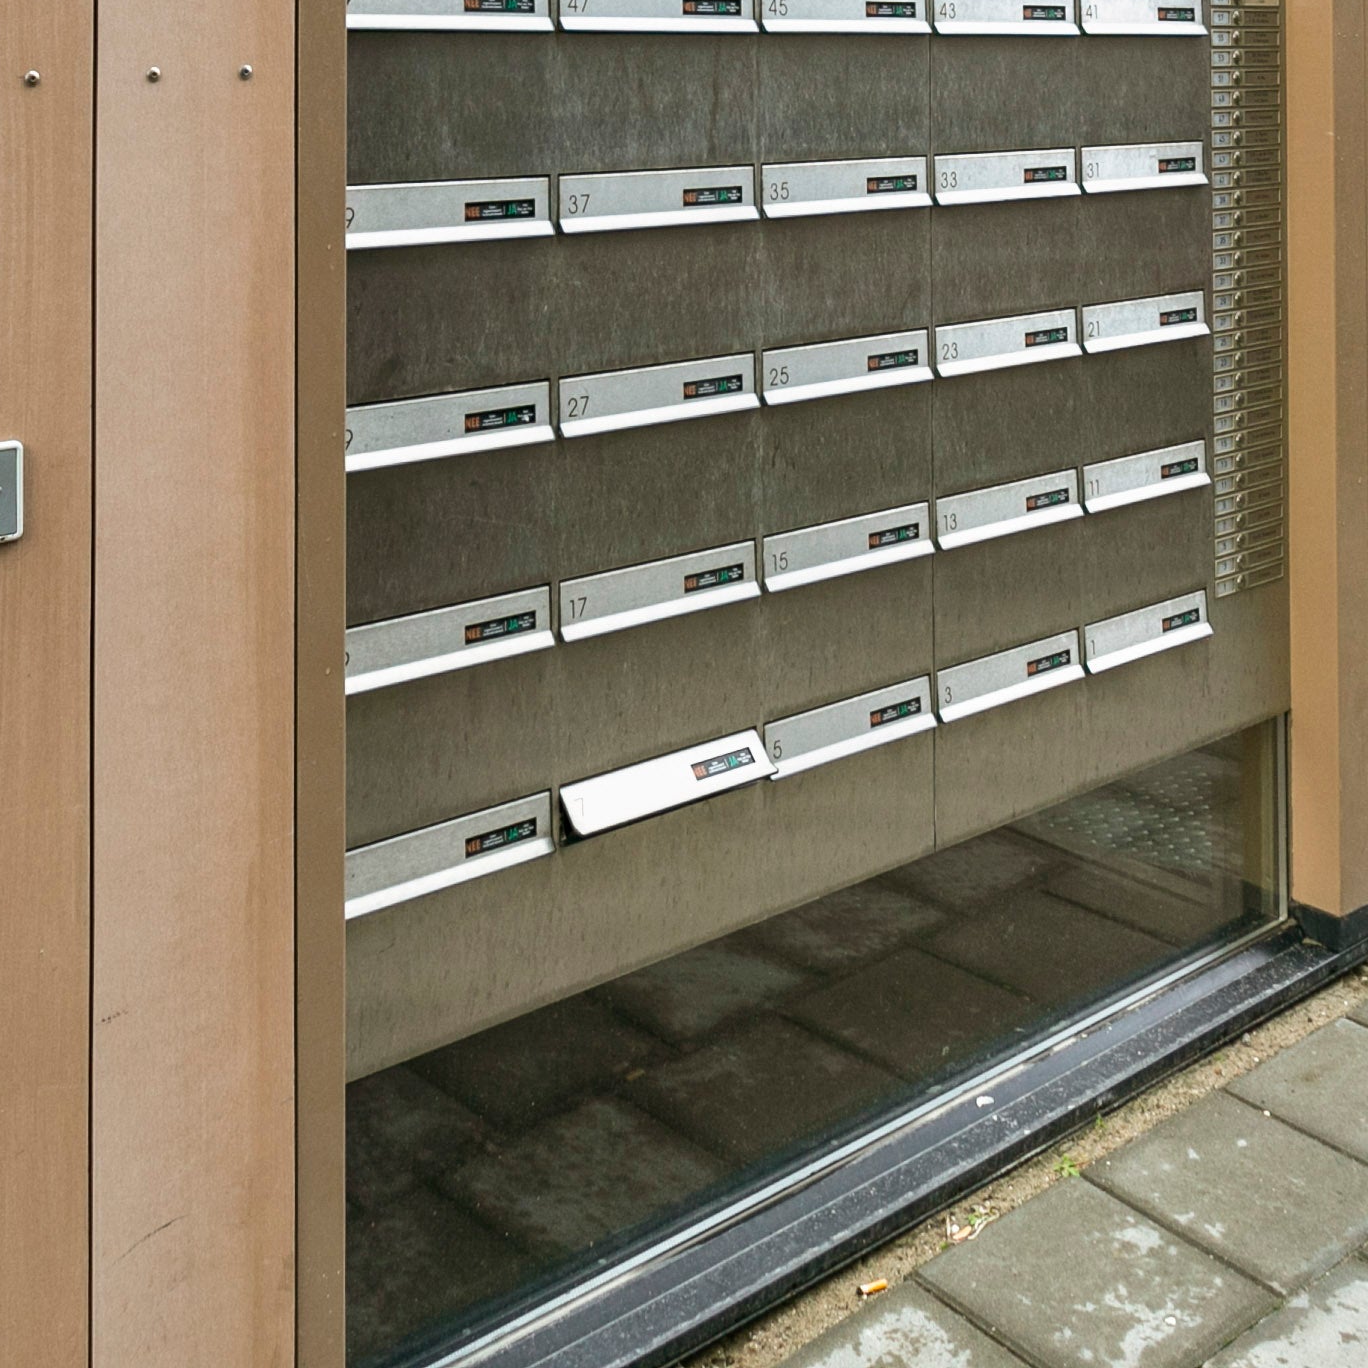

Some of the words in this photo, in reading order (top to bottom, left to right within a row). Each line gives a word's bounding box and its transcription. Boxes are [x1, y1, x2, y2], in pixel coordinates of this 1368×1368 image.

[940, 3, 956, 19] 43
[1086, 4, 1098, 20] 41
[1087, 163, 1099, 178] 31
[941, 172, 957, 188] 33
[770, 182, 789, 200] 35
[465, 206, 480, 217] NEE
[507, 203, 518, 215] JA
[569, 194, 589, 214] 37
[1089, 321, 1099, 337] 21
[942, 342, 958, 360] 23
[770, 367, 789, 386] 25
[568, 396, 589, 417] 27
[465, 417, 480, 428] NEE
[506, 411, 519, 424] JA
[1089, 479, 1100, 496] 11
[944, 514, 957, 530] 13
[773, 552, 788, 571] 15
[570, 597, 587, 619] 17
[465, 627, 481, 639] NEE
[508, 619, 520, 631] JA
[1091, 639, 1096, 655] 1
[945, 687, 952, 703] 3
[773, 740, 782, 759] 5
[508, 827, 519, 840] JA
[466, 840, 481, 852] NEE
